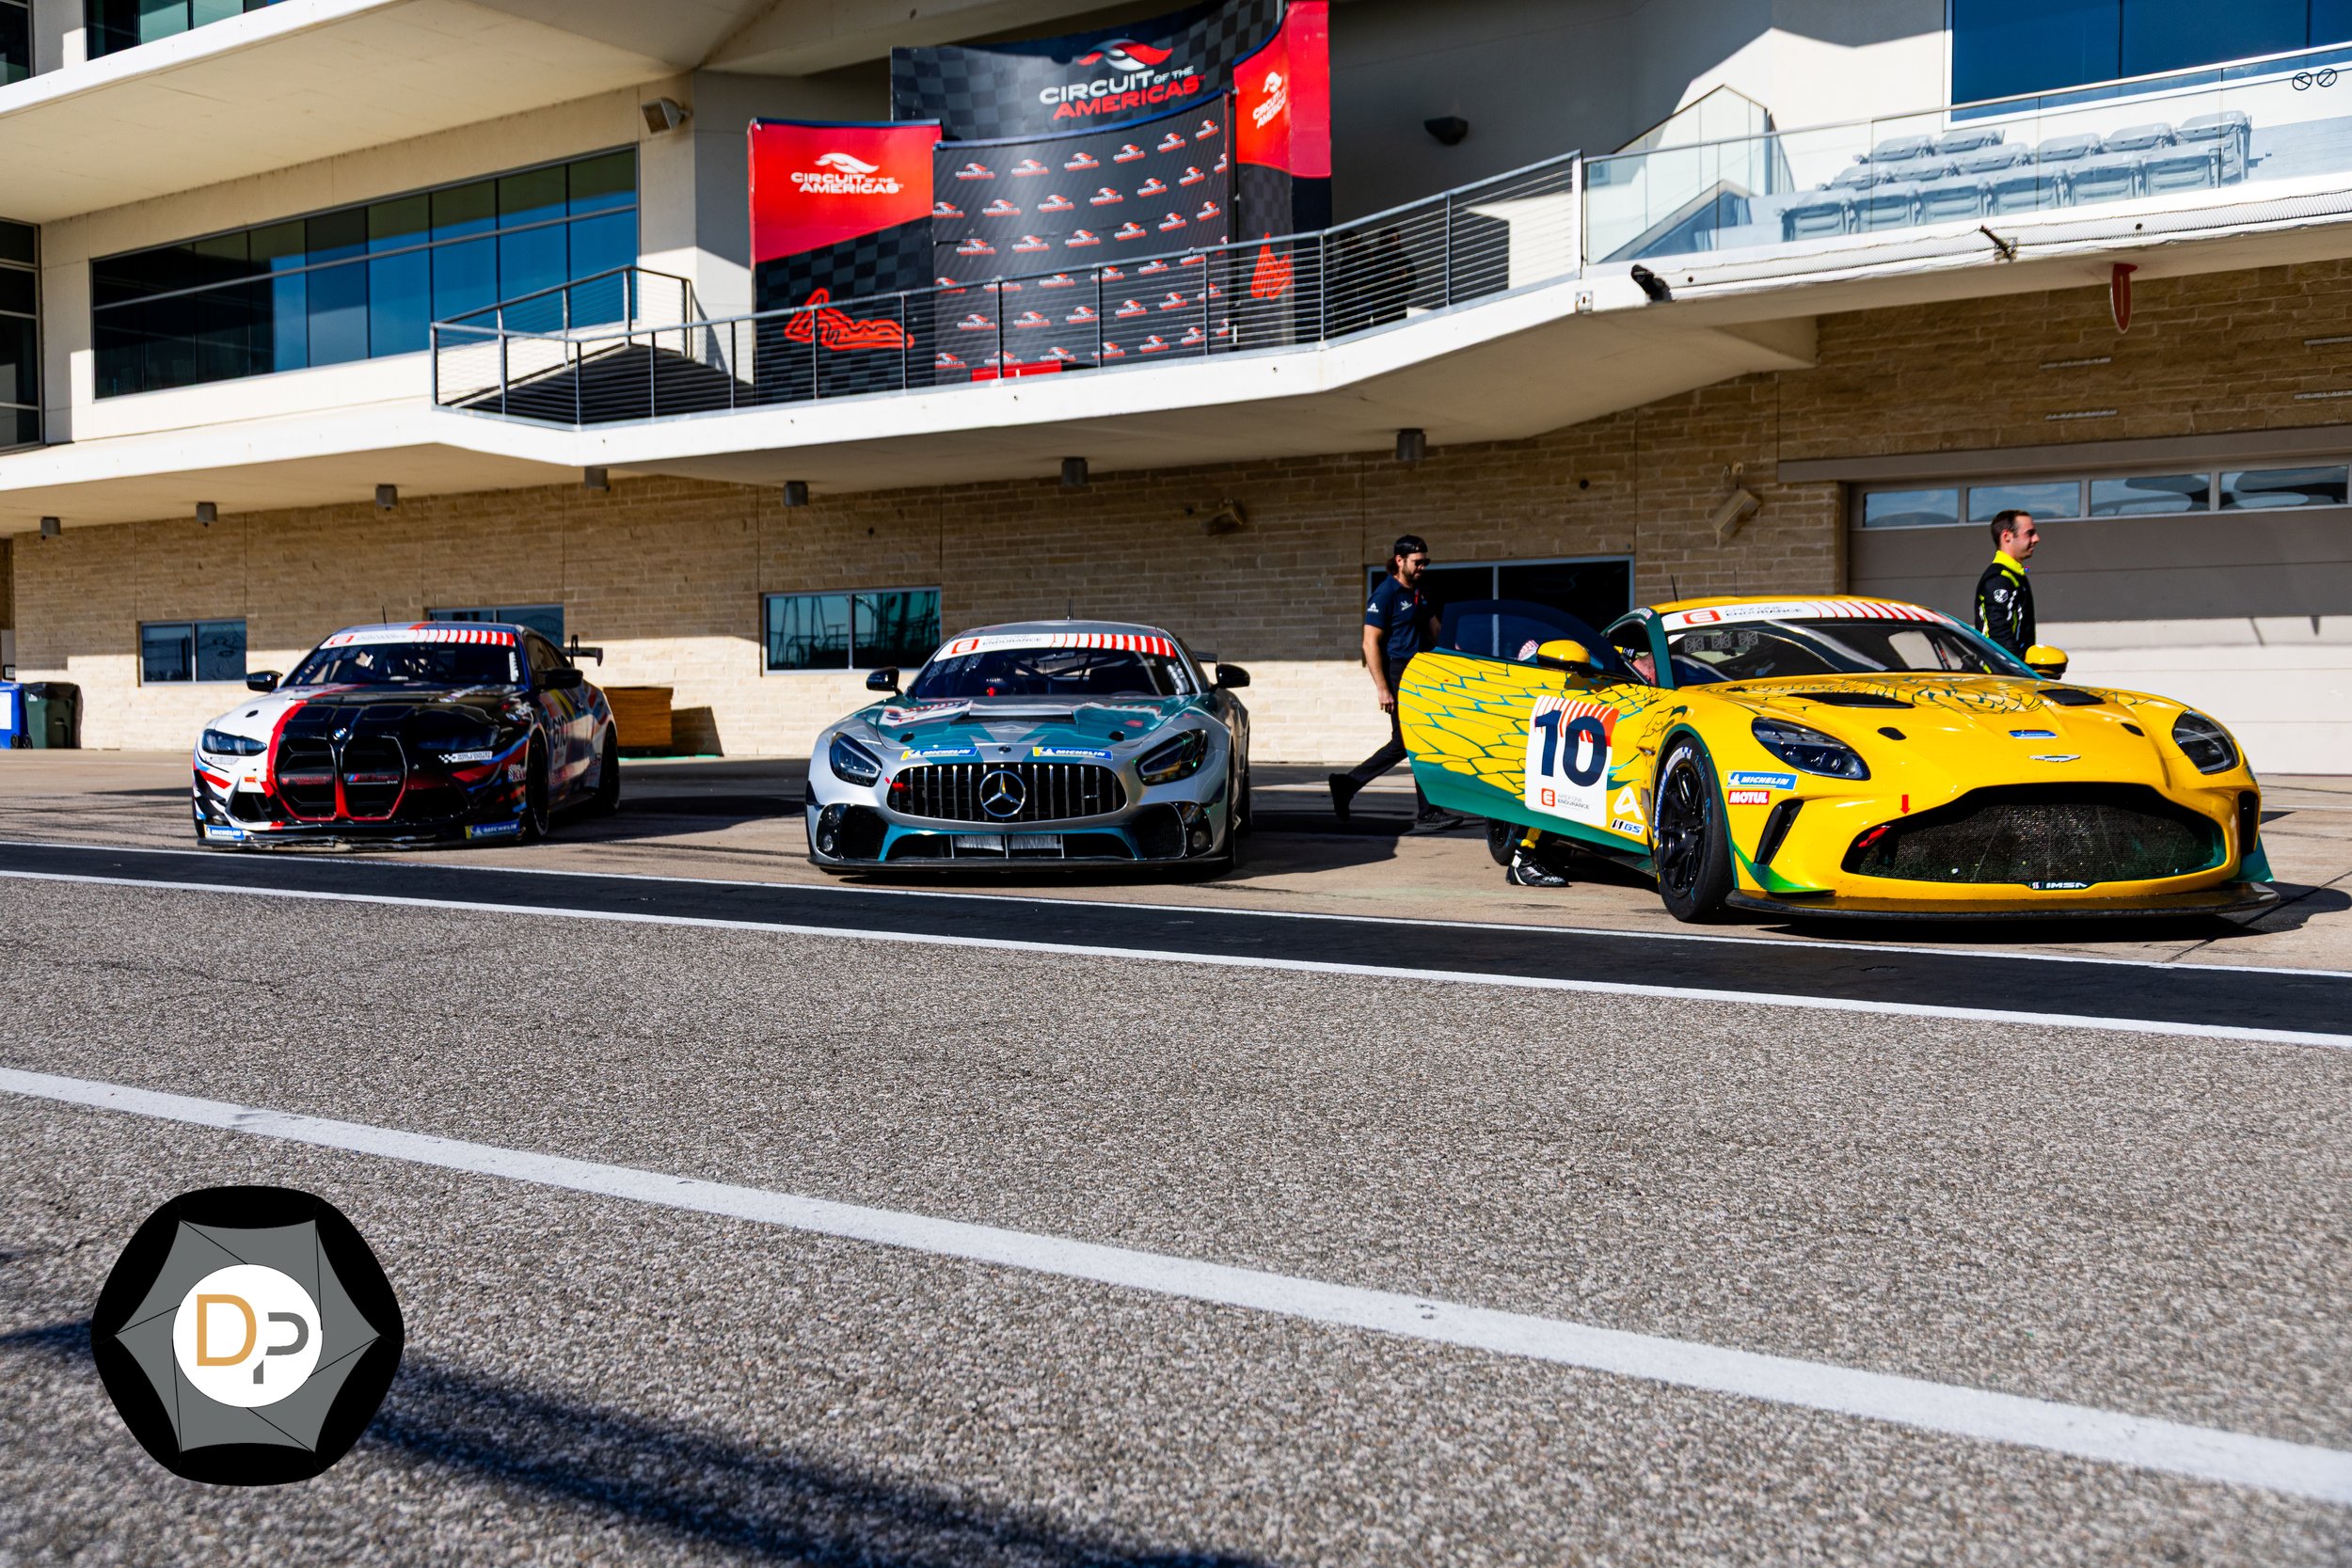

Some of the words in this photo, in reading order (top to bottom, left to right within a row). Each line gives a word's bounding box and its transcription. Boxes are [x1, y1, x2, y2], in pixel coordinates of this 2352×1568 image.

[1039, 69, 1154, 105] CIRCUIT
[1153, 72, 1169, 85] OF
[1171, 65, 1194, 80] THE
[1052, 75, 1200, 120] AMERICAS
[790, 172, 866, 183] CIRCUIT
[799, 182, 899, 194] AMERICAS
[1725, 608, 1802, 617] ENDURANCE
[982, 638, 1042, 646] ENDURANCE
[1534, 709, 1607, 786] 10
[1740, 775, 1790, 785] MICHELIN
[1729, 791, 1768, 804] MOTUL
[1557, 799, 1590, 810] ENDURANCE
[1624, 823, 1643, 833] GS
